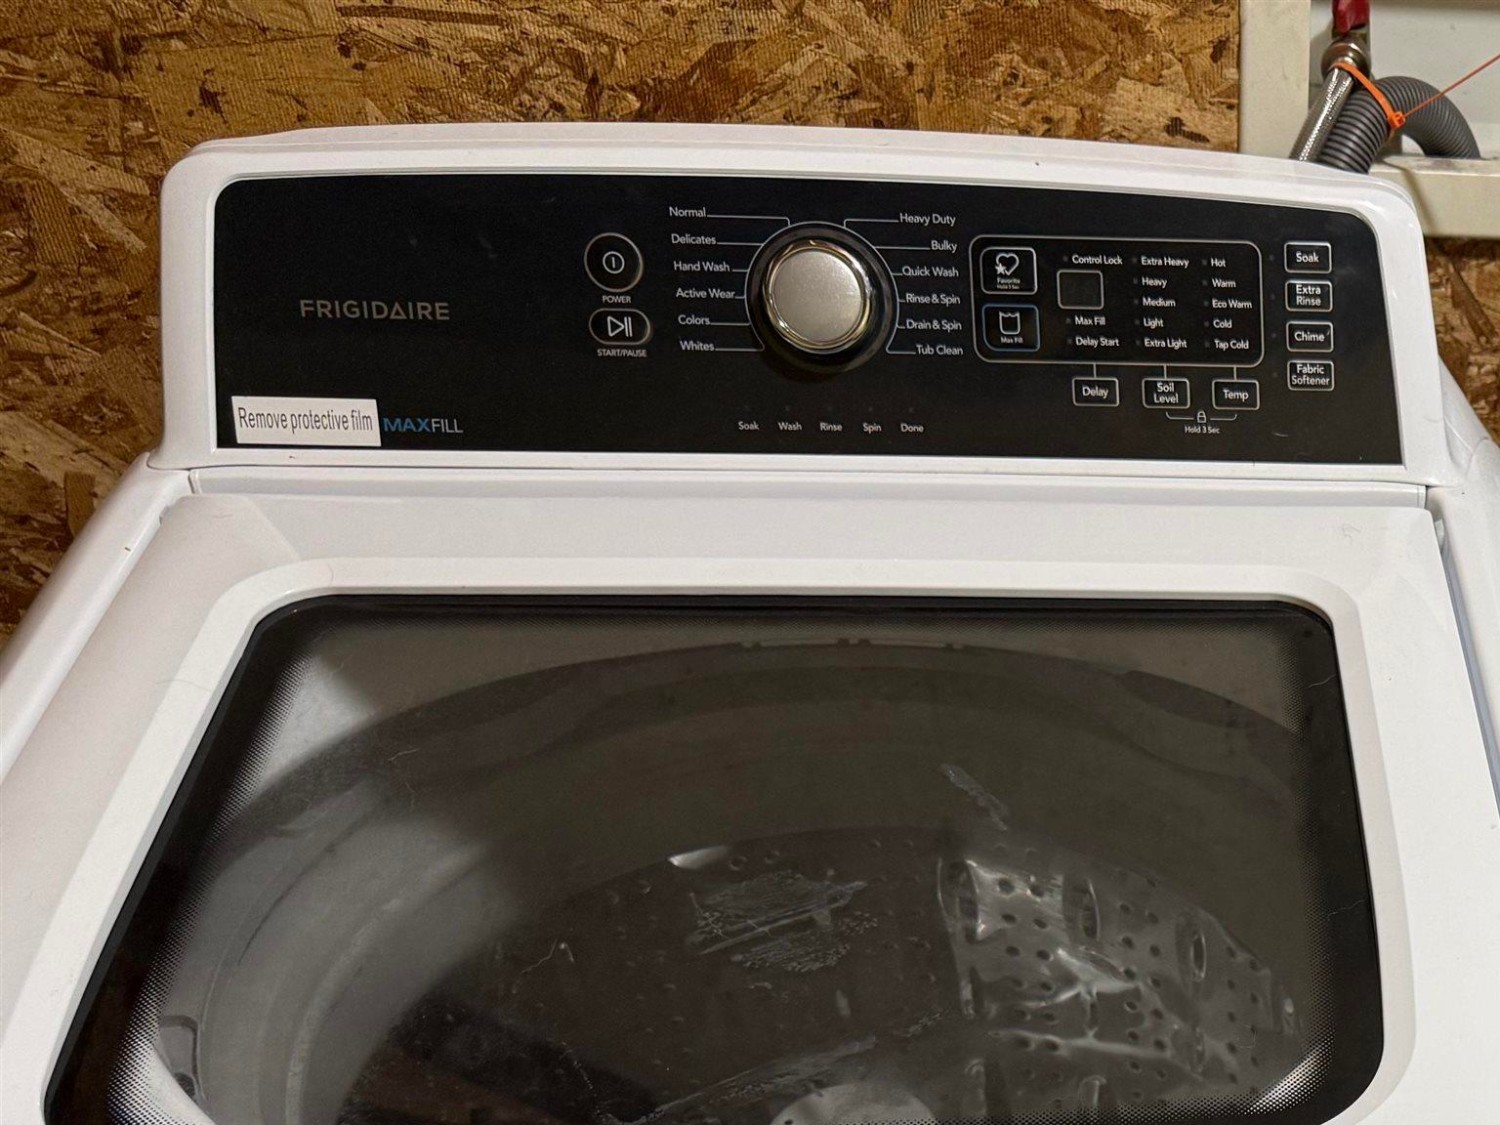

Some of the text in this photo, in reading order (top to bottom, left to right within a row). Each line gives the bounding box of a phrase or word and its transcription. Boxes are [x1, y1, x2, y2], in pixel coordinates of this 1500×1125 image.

[669, 207, 706, 217] Normal
[900, 213, 956, 227] Heavy Duty
[671, 234, 716, 245] Delicates
[931, 240, 957, 253] Bulky
[1072, 255, 1123, 265] Control Lock
[1141, 256, 1189, 268] Extra Heavy
[1295, 251, 1319, 263] Soak
[674, 261, 730, 272] Hand Wash
[1211, 258, 1226, 268] Hot
[902, 266, 959, 277] Quick Wash
[1142, 277, 1167, 288] Heavy
[1212, 279, 1236, 288] Warm
[676, 288, 735, 299] Active Wear
[1296, 284, 1321, 295] Extra
[602, 295, 631, 303] POWER
[906, 293, 960, 307] Rinse & Spin
[1142, 297, 1176, 307] Medium
[1212, 299, 1252, 309] Eco Warm
[1296, 296, 1321, 306] Rinse
[300, 300, 450, 320] FRIGIDAIRE
[678, 315, 710, 325] Colors
[1075, 316, 1106, 325] Max Fill
[1143, 318, 1164, 329] Light
[1213, 319, 1232, 329] Cold
[907, 320, 962, 332] Drain & Spin
[1075, 336, 1120, 348] Delay Start
[1294, 331, 1325, 342] Chime
[680, 341, 714, 351] Whites
[916, 344, 963, 356] Tub Clean
[1144, 339, 1187, 350] Extra Light
[1214, 340, 1249, 350] Tap Cold
[597, 349, 647, 357] START/PAUSE
[1296, 364, 1324, 374] Fabric
[1291, 375, 1329, 386] Softener
[1082, 386, 1108, 400] Delay
[1156, 382, 1175, 393] Soil
[1153, 393, 1179, 404] Level
[1223, 389, 1249, 402] Temp
[238, 407, 373, 434] Remove protective film
[738, 421, 760, 430] Soak
[778, 422, 802, 431] Wash
[820, 422, 843, 432] Rinse
[863, 422, 882, 434] Spin
[900, 423, 924, 432] Done
[1184, 425, 1220, 434] Hold 3 Sec
